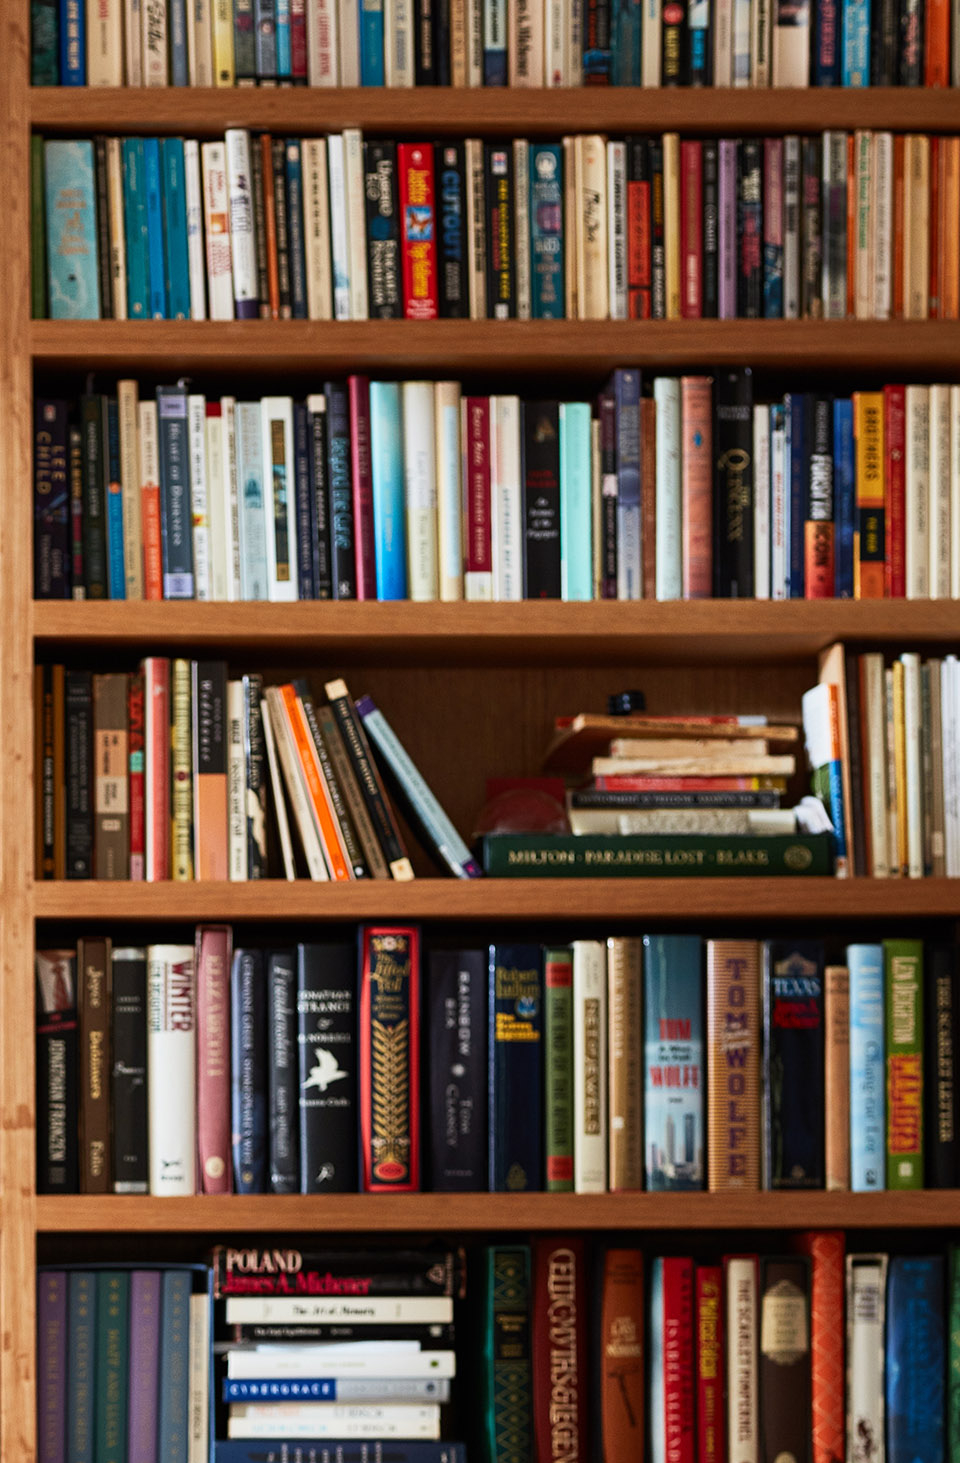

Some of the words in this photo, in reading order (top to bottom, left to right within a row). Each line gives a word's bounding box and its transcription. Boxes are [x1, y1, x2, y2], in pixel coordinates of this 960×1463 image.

[366, 173, 380, 200] ECO
[377, 160, 392, 217] UMBERTO
[443, 171, 461, 260] CUTOUT
[36, 431, 52, 495] CHILD
[51, 445, 66, 481] LEE
[87, 966, 103, 1008] Joyce
[171, 961, 192, 1031] WINTER
[458, 971, 470, 1056] RAINBOW
[726, 957, 747, 1030] TOM
[938, 977, 951, 1009] THE
[659, 1018, 691, 1040] TOM
[938, 1011, 952, 1078] SCARLET
[48, 1039, 66, 1102] JONATHAN
[649, 1064, 700, 1088] WOLFE
[49, 1103, 66, 1161] FRANZEN
[727, 1045, 746, 1177] WOLFE
[865, 1126, 879, 1152] Lee
[938, 1081, 953, 1143] LETTER
[90, 1141, 104, 1176] Folio
[226, 1250, 302, 1272] POLAND
[298, 1271, 373, 1294] Michener
[737, 1279, 751, 1302] THE
[666, 1319, 680, 1383] ISABEL
[738, 1306, 751, 1364] SCARLET
